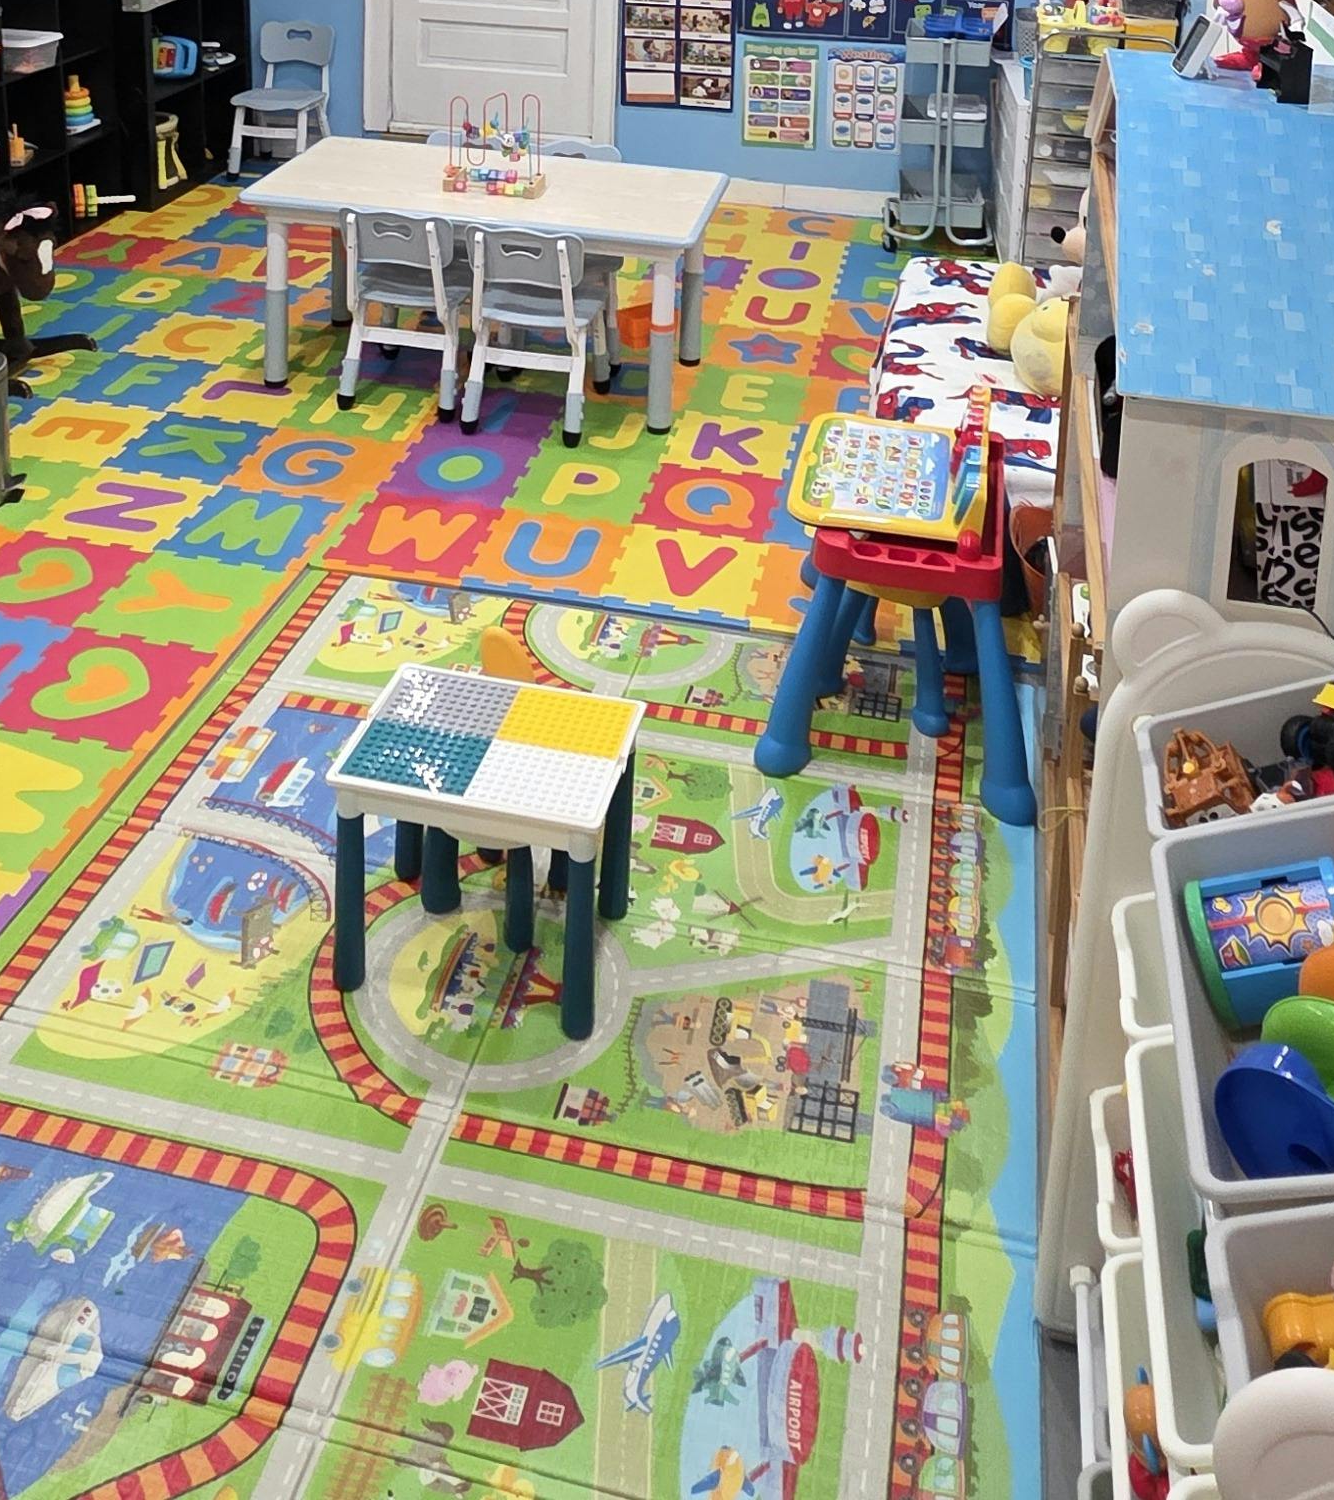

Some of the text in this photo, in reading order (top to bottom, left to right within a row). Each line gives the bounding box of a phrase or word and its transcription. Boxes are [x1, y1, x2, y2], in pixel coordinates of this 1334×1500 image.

[160, 247, 221, 271] A
[116, 277, 183, 303] B
[745, 296, 811, 325] U
[163, 320, 236, 353] C
[102, 362, 180, 396] F
[720, 374, 774, 412] E
[31, 415, 131, 446] E
[310, 392, 406, 431] H
[139, 424, 247, 464] K
[261, 440, 356, 486] G
[690, 422, 763, 466] K
[417, 445, 505, 493] O
[543, 462, 620, 505] P
[664, 476, 756, 529] Q
[367, 504, 478, 562] W
[503, 519, 603, 579] U
[655, 538, 739, 597] V
[114, 569, 233, 614] Y
[787, 1378, 803, 1452] AIRPORT
